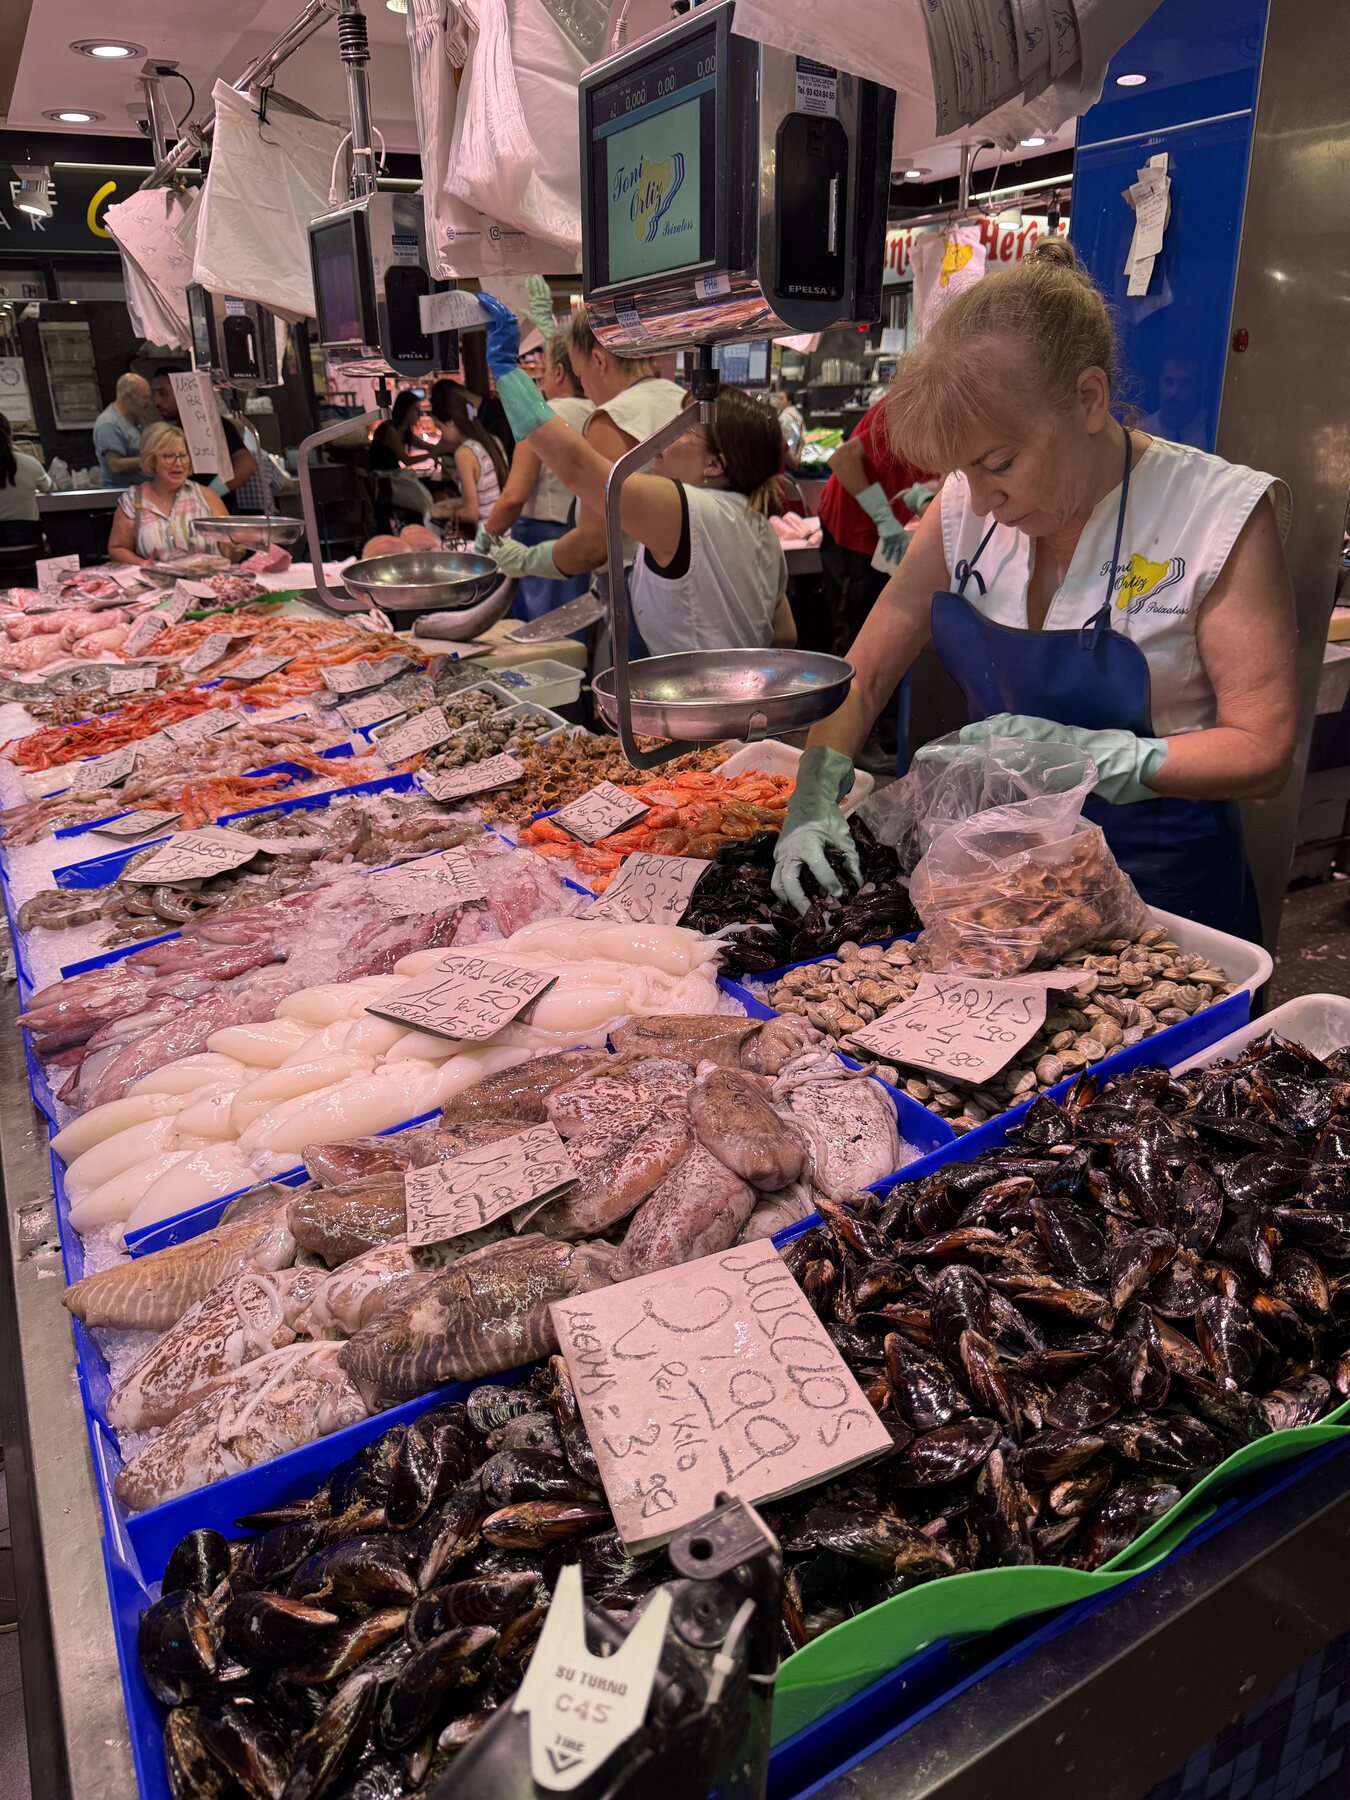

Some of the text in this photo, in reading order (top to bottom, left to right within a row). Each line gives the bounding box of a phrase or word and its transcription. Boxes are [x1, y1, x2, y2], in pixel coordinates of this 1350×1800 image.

[657, 74, 676, 97] 0,00
[612, 154, 644, 203] Toni
[630, 181, 663, 222] Ortiz
[788, 284, 828, 295] EPELSA
[1100, 560, 1132, 576] Tni
[1114, 575, 1147, 592] Ortiz
[610, 1285, 800, 1485] 2'99
[555, 1665, 628, 1697] SU TURNO
[555, 1693, 613, 1725] C45
